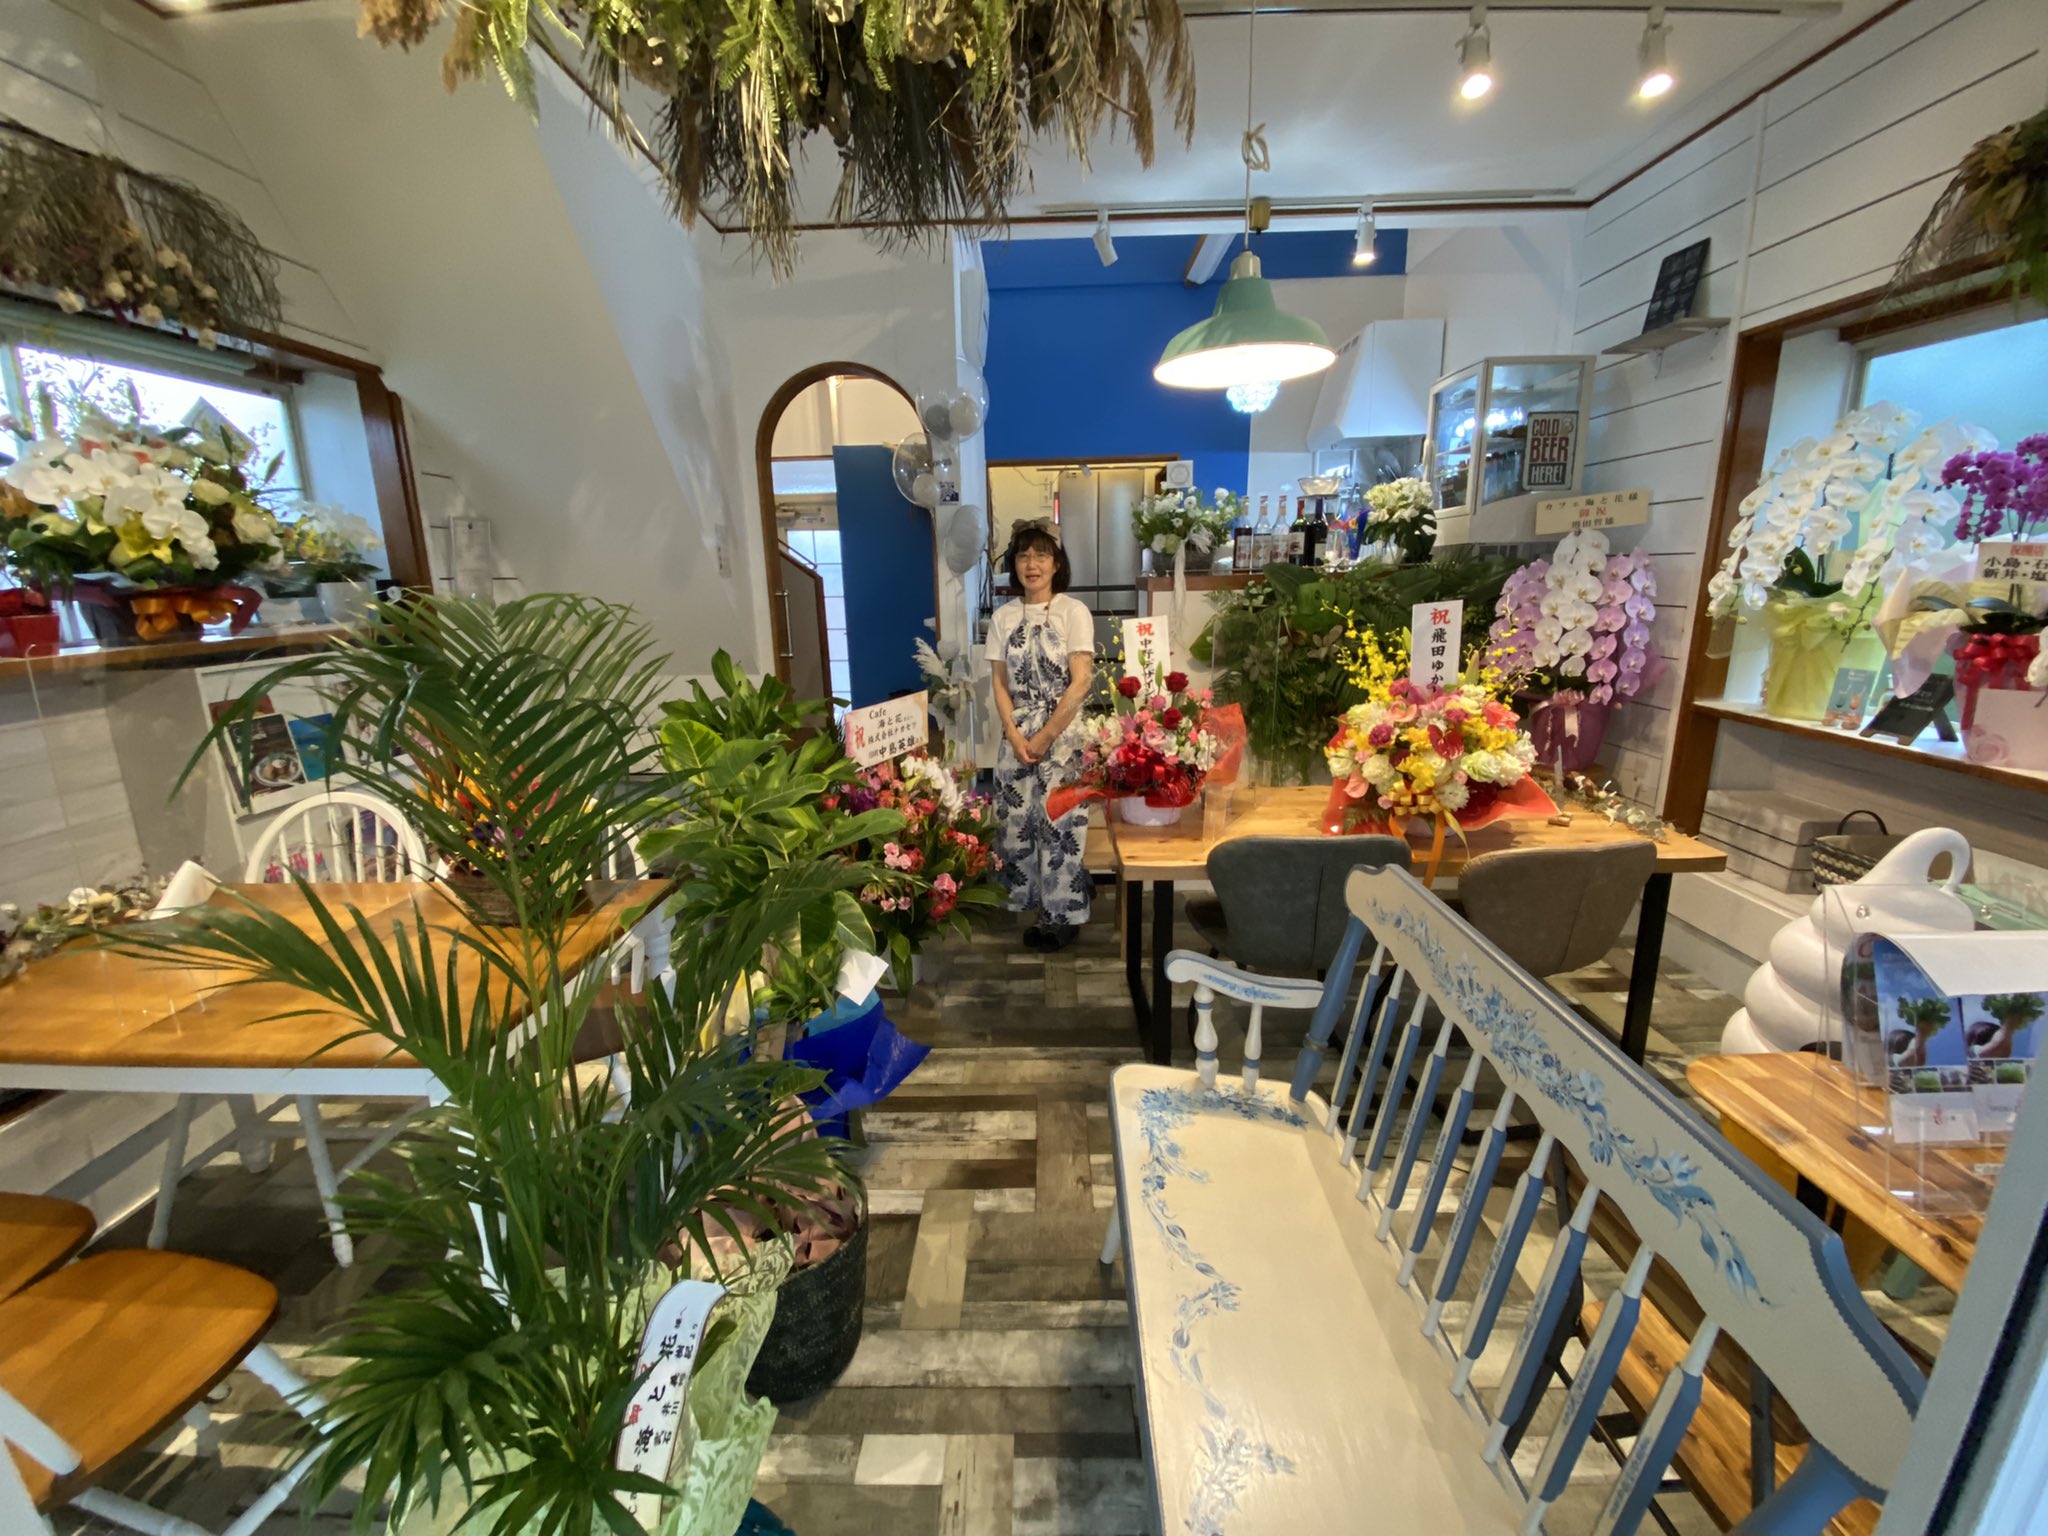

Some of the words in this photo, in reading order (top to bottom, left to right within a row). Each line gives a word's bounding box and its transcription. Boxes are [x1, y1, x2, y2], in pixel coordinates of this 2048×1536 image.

[1532, 418, 1560, 437] COLD
[1529, 436, 1570, 463] BEER
[1530, 465, 1563, 484] HERE!
[1430, 607, 1451, 625] 祝
[1136, 621, 1155, 637] 祝
[868, 707, 887, 720] Cafe
